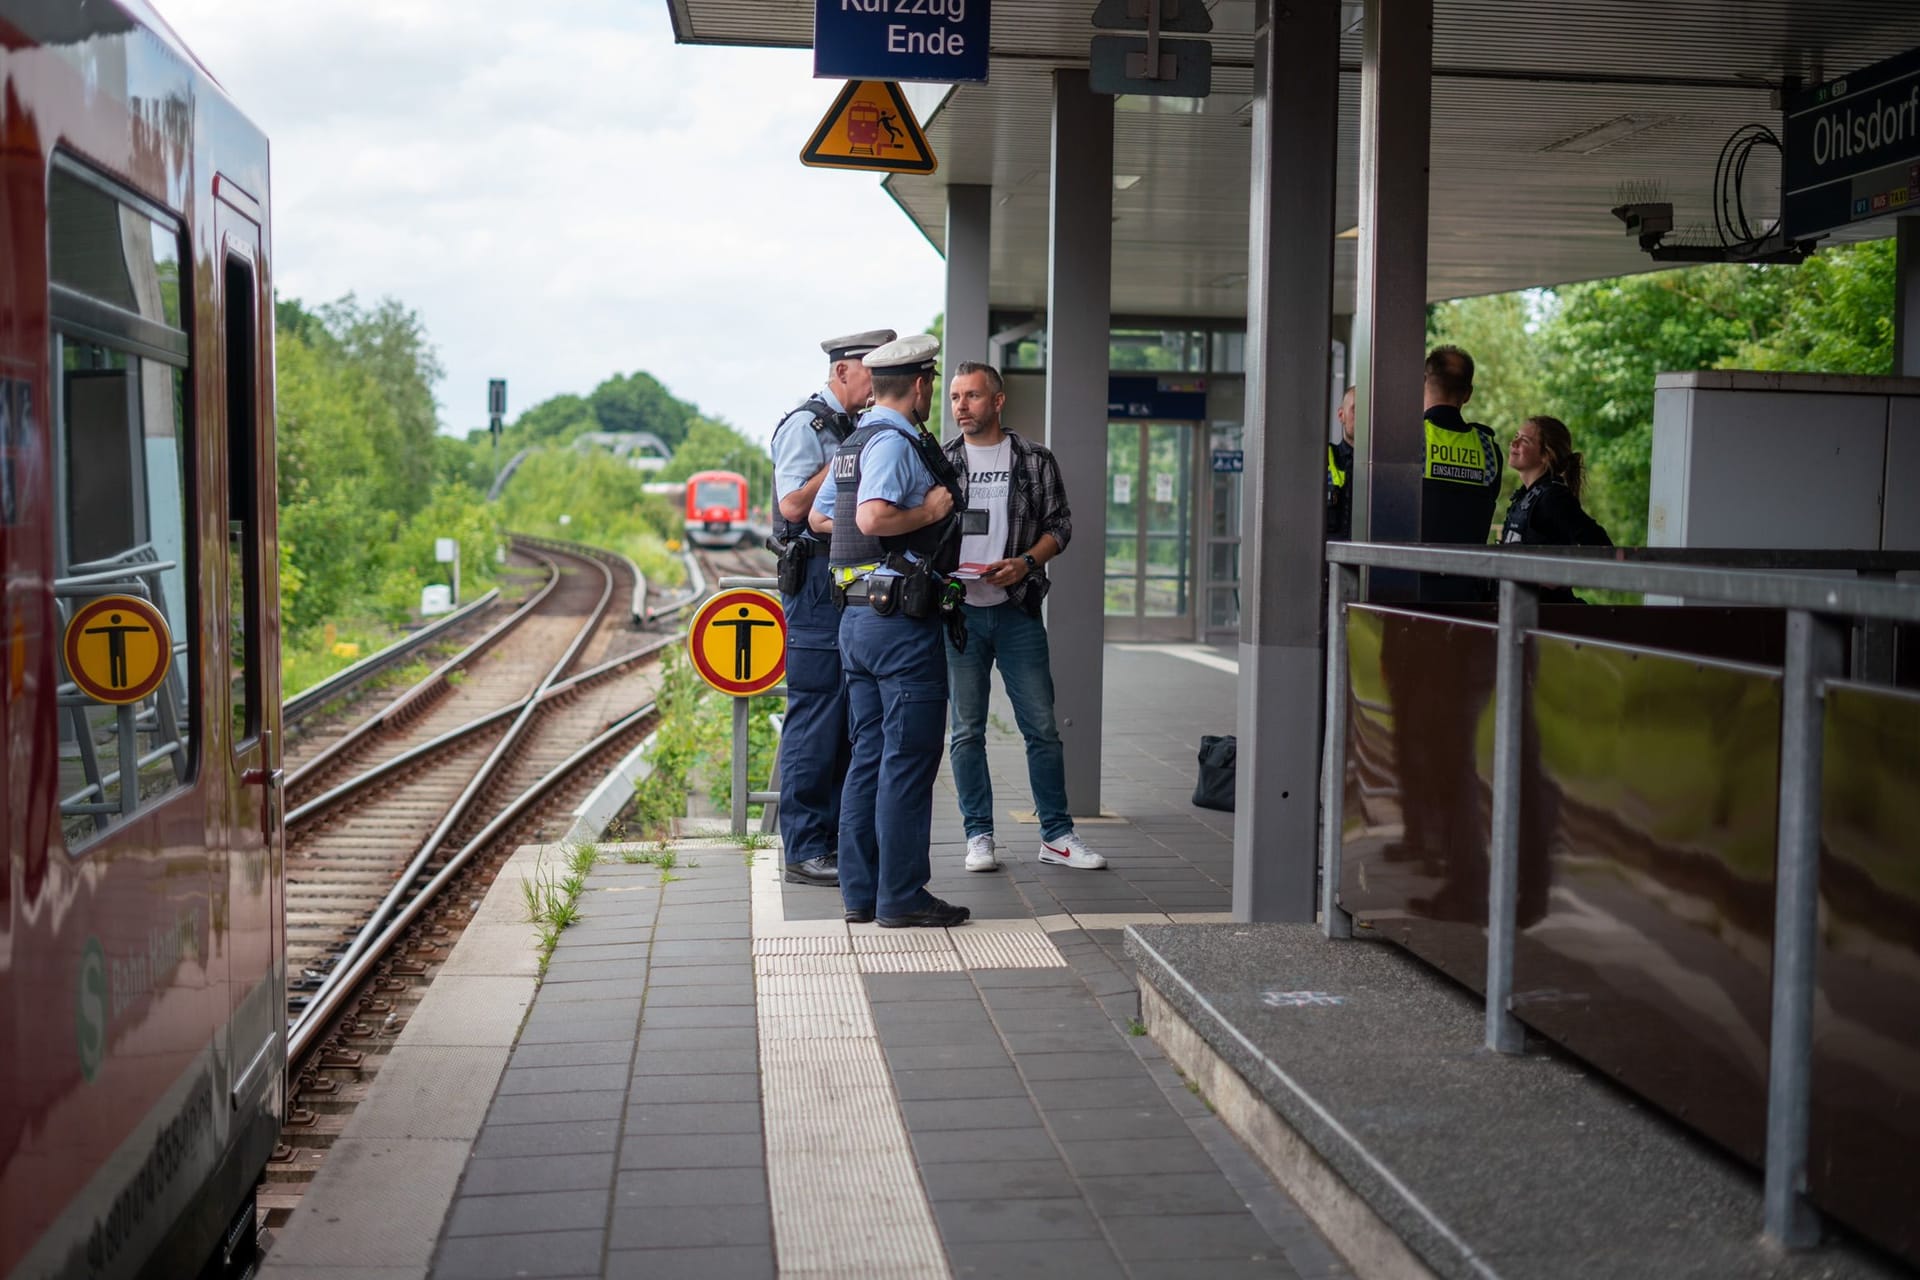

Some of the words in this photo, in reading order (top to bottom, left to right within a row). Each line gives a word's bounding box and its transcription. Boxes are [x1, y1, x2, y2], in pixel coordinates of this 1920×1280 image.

[888, 24, 965, 56] Ende
[1813, 85, 1919, 166] Ohlsdorf
[1431, 444, 1480, 465] POLIZEI
[968, 471, 1009, 483] LISTE
[1433, 465, 1482, 480] EINSATZLEITUNG
